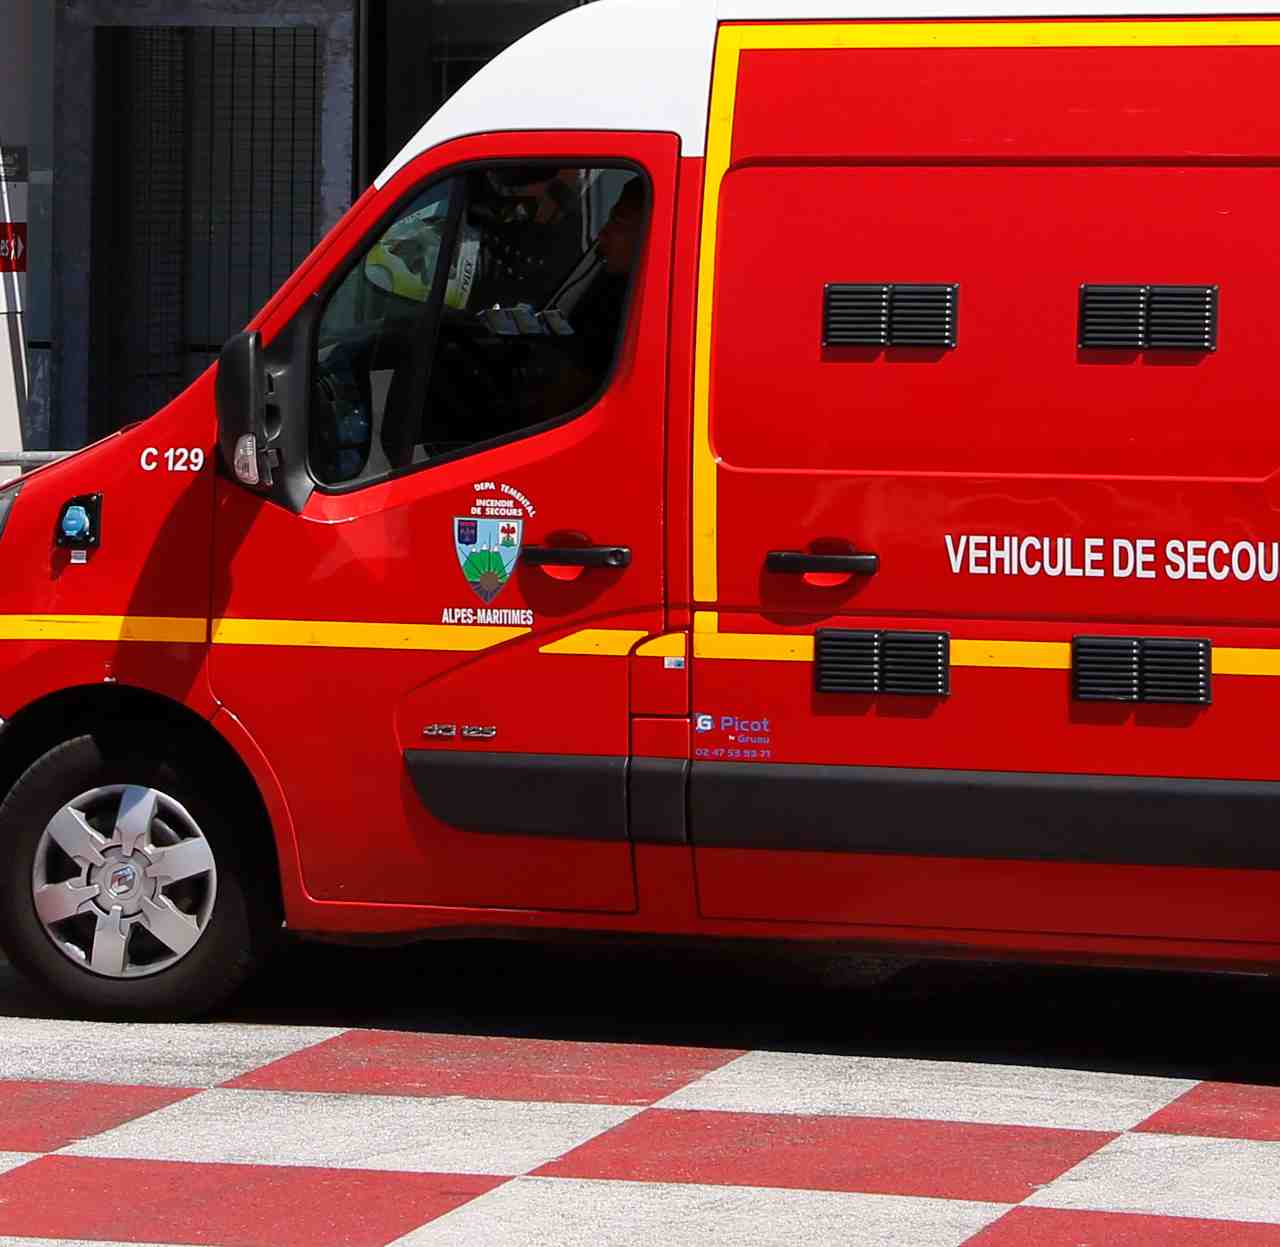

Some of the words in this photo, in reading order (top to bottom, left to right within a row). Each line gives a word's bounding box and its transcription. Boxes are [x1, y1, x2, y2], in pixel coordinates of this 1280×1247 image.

[140, 448, 158, 471] C
[163, 448, 205, 472] 129
[476, 498, 514, 508] INCENDIE
[470, 507, 481, 516] DE
[485, 507, 524, 517] SECOURS
[944, 534, 1105, 577] VEHICULE
[1113, 538, 1156, 579] DE
[442, 608, 534, 626] ALPES-MARITIMES
[720, 716, 769, 732] Picot
